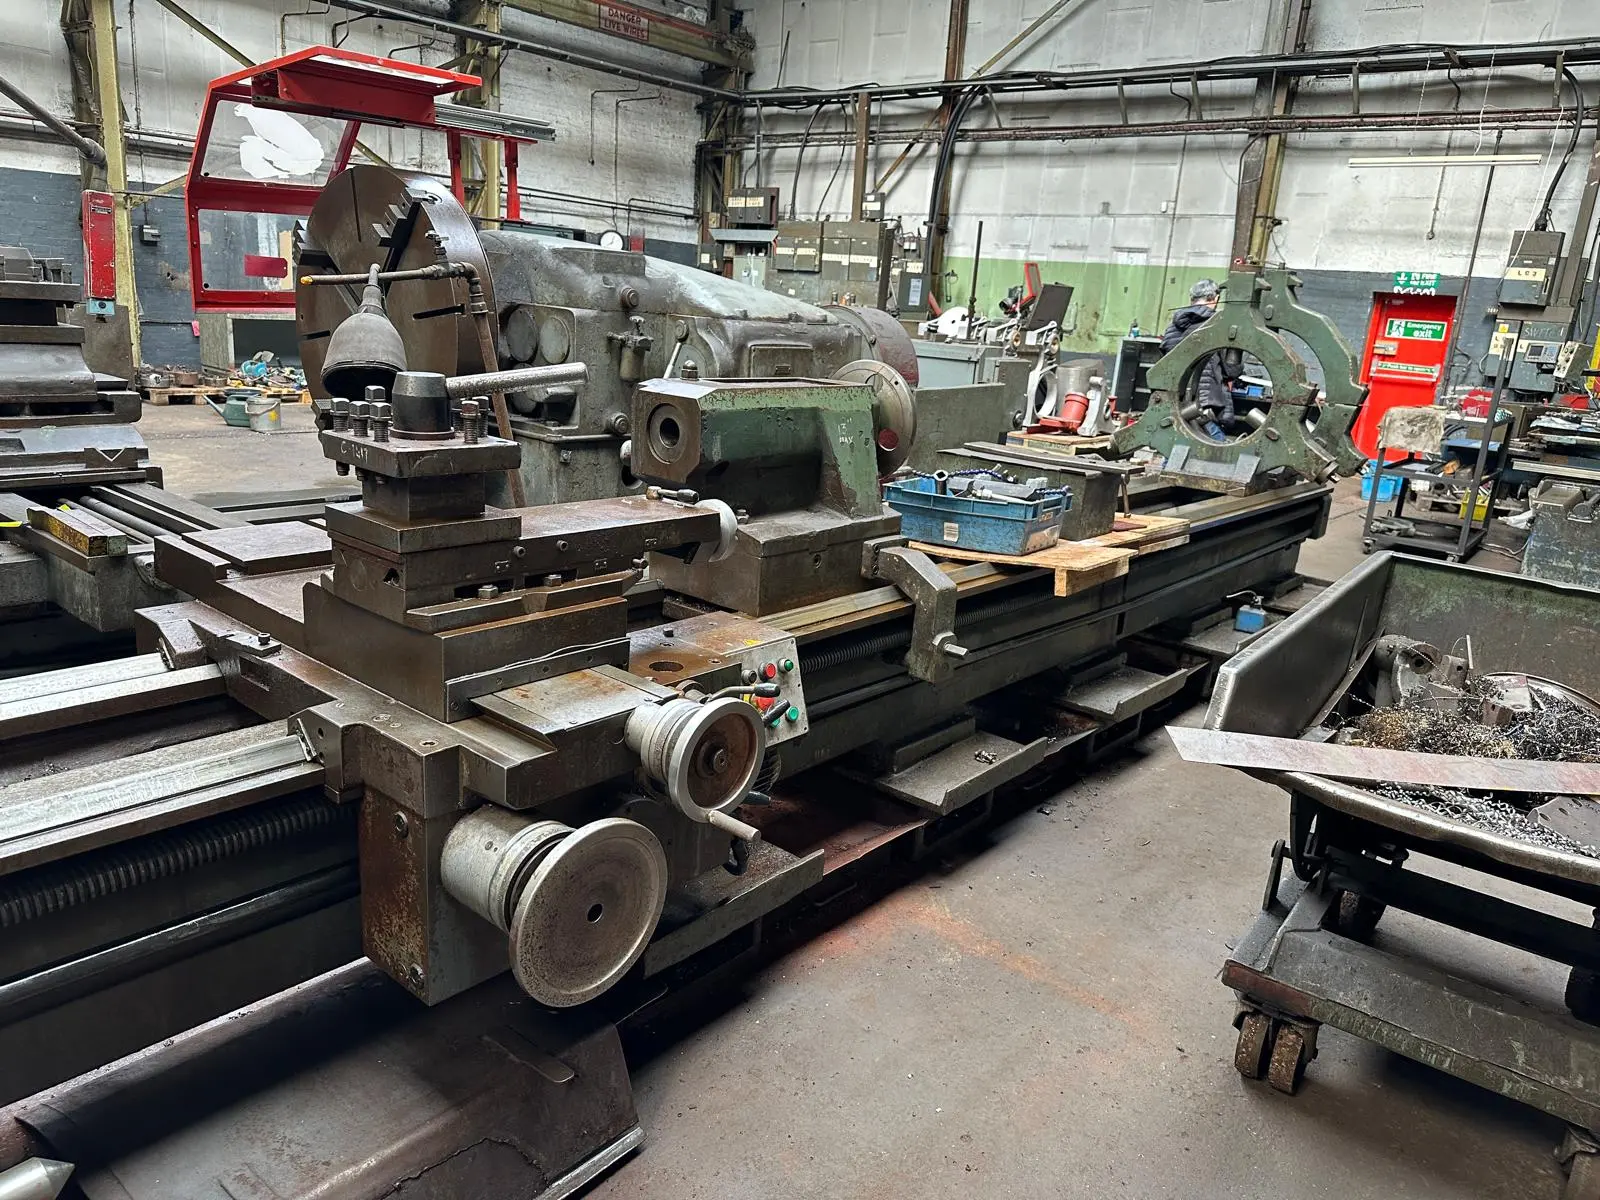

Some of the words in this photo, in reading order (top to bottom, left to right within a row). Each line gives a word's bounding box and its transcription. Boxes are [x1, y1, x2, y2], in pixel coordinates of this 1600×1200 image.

[608, 8, 641, 25] DANGER
[604, 19, 621, 31] LIVE
[623, 24, 646, 39] WIRES
[1407, 322, 1442, 331] Emergency
[1413, 329, 1433, 338] exit
